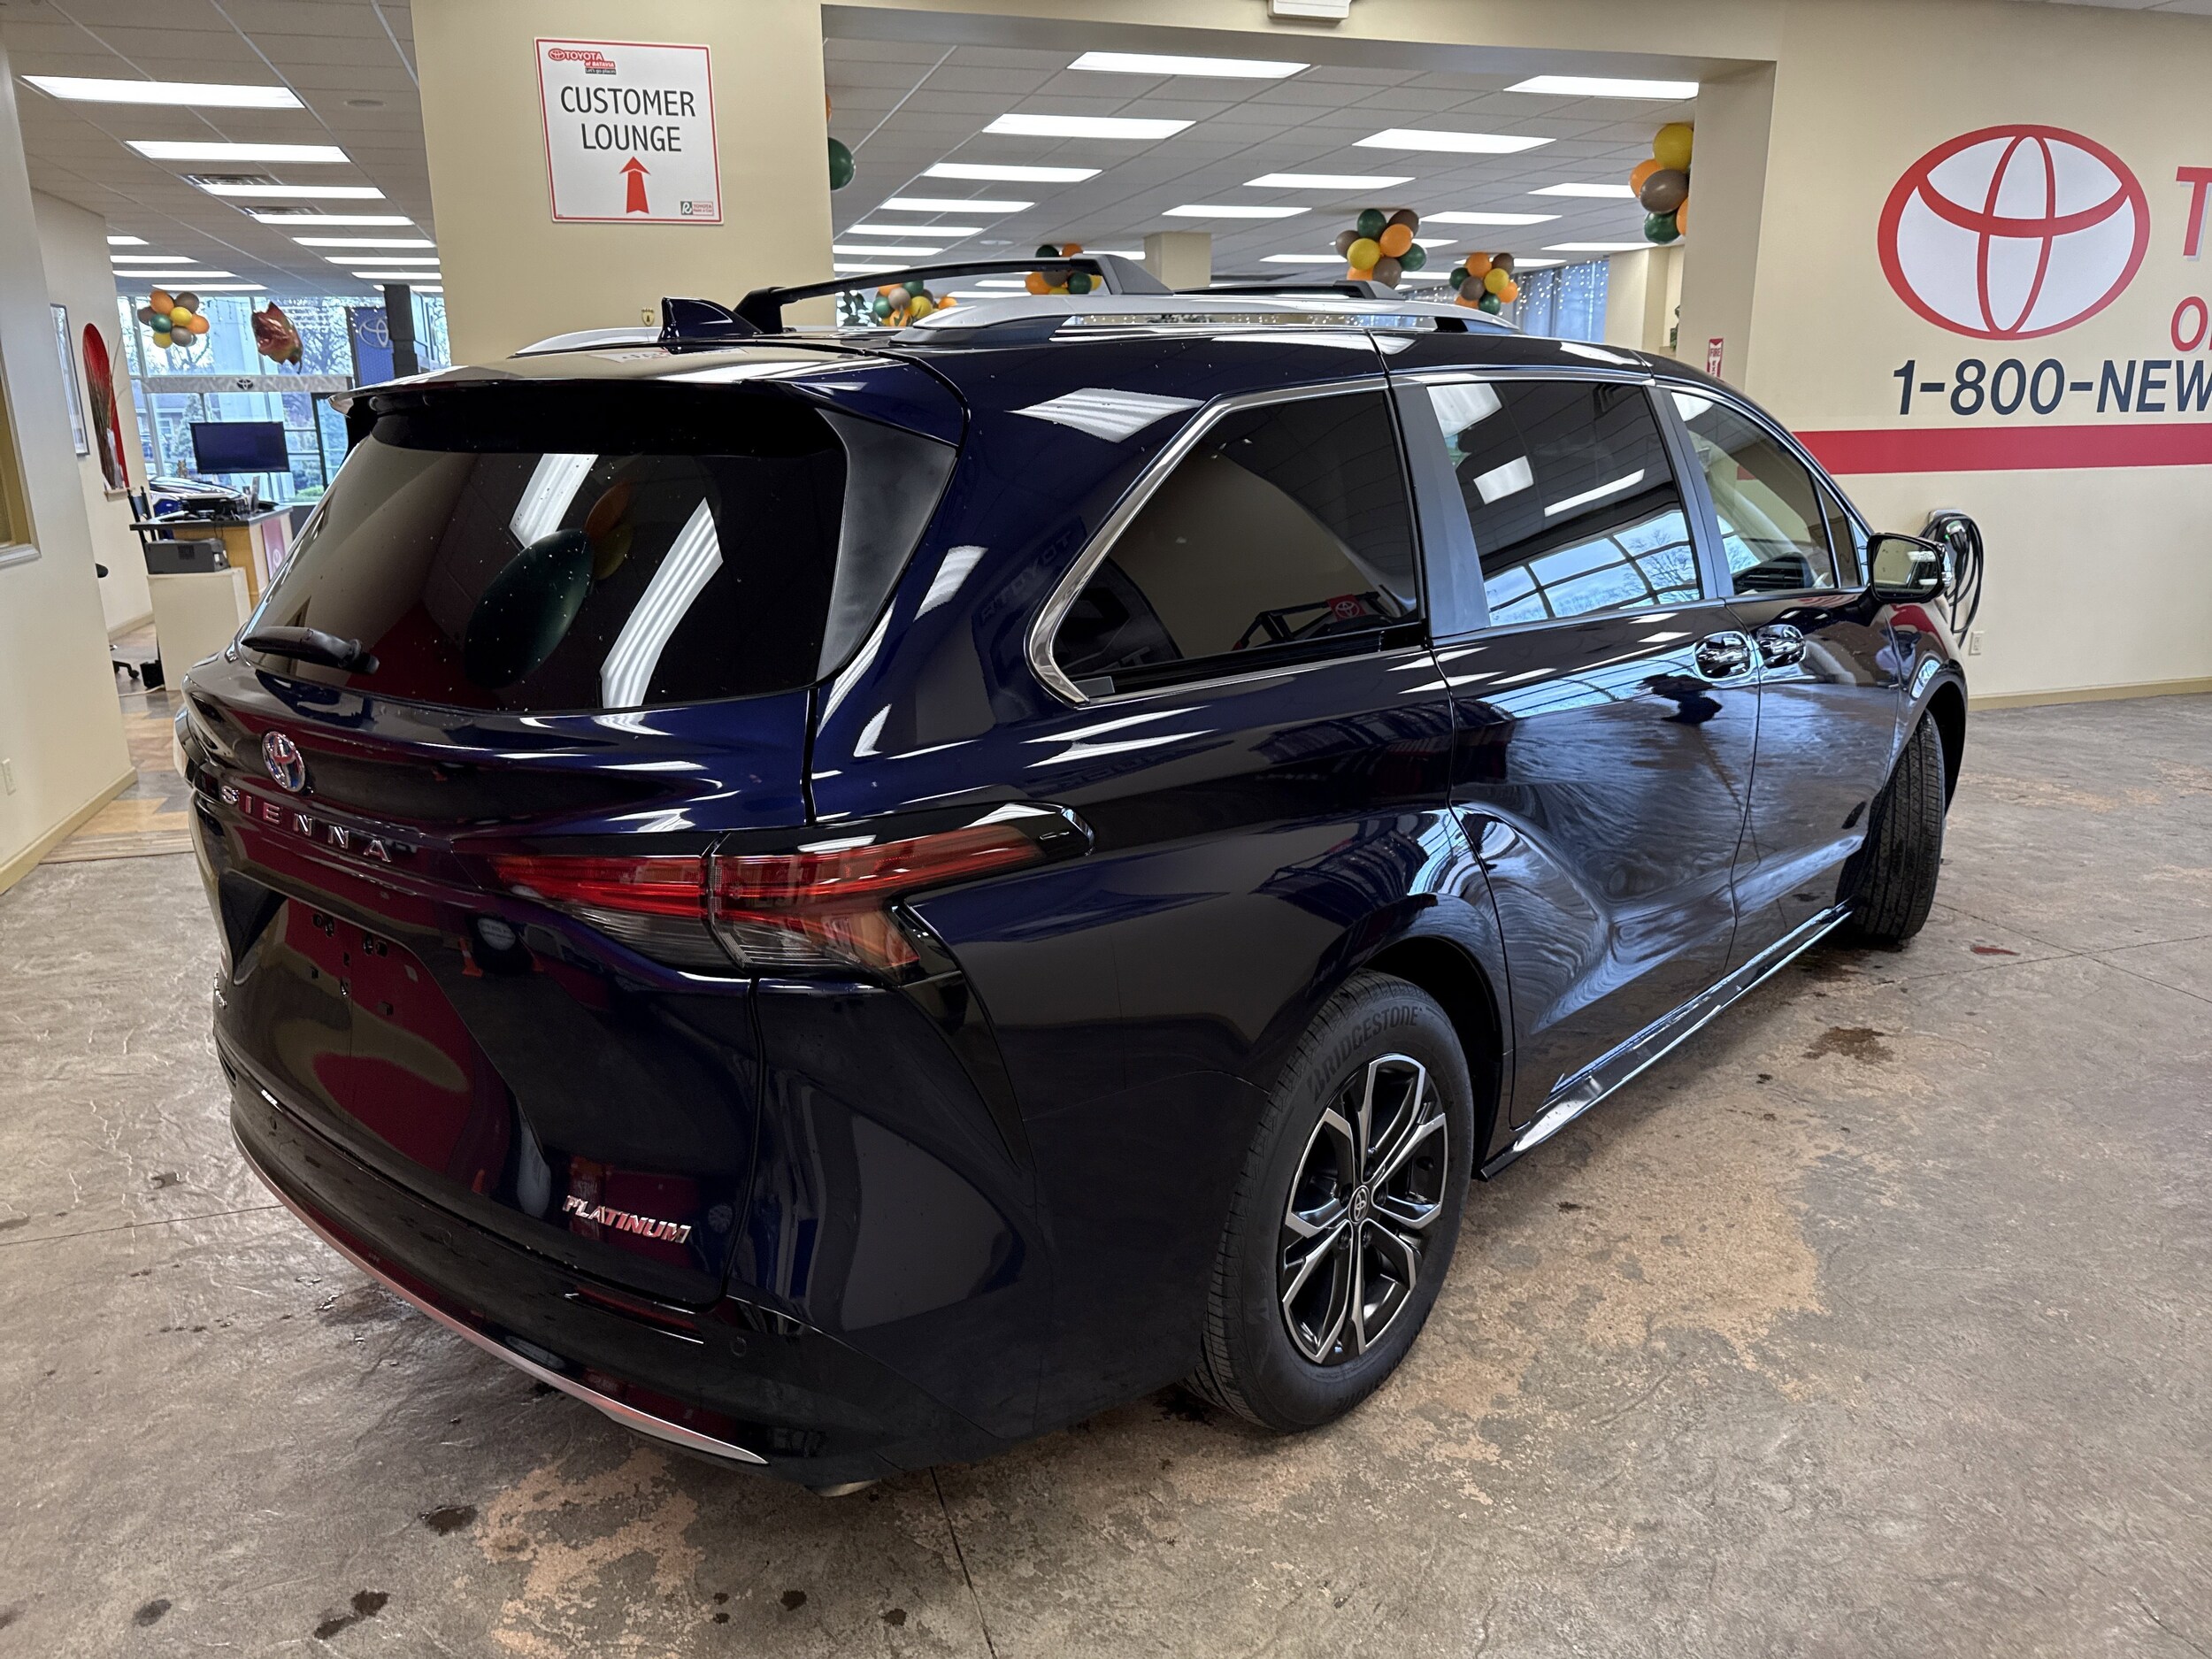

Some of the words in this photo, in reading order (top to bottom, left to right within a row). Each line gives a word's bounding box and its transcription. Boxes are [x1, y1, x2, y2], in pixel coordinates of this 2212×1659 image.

[565, 51, 603, 61] TOYOTA
[560, 86, 696, 117] CUSTOMER
[580, 123, 682, 152] LOUNGE
[2170, 296, 2212, 352] O
[221, 785, 392, 863] SIENNA
[1307, 1005, 1419, 1102] BRIDGESTONE
[562, 1194, 692, 1244] PLATINUM
